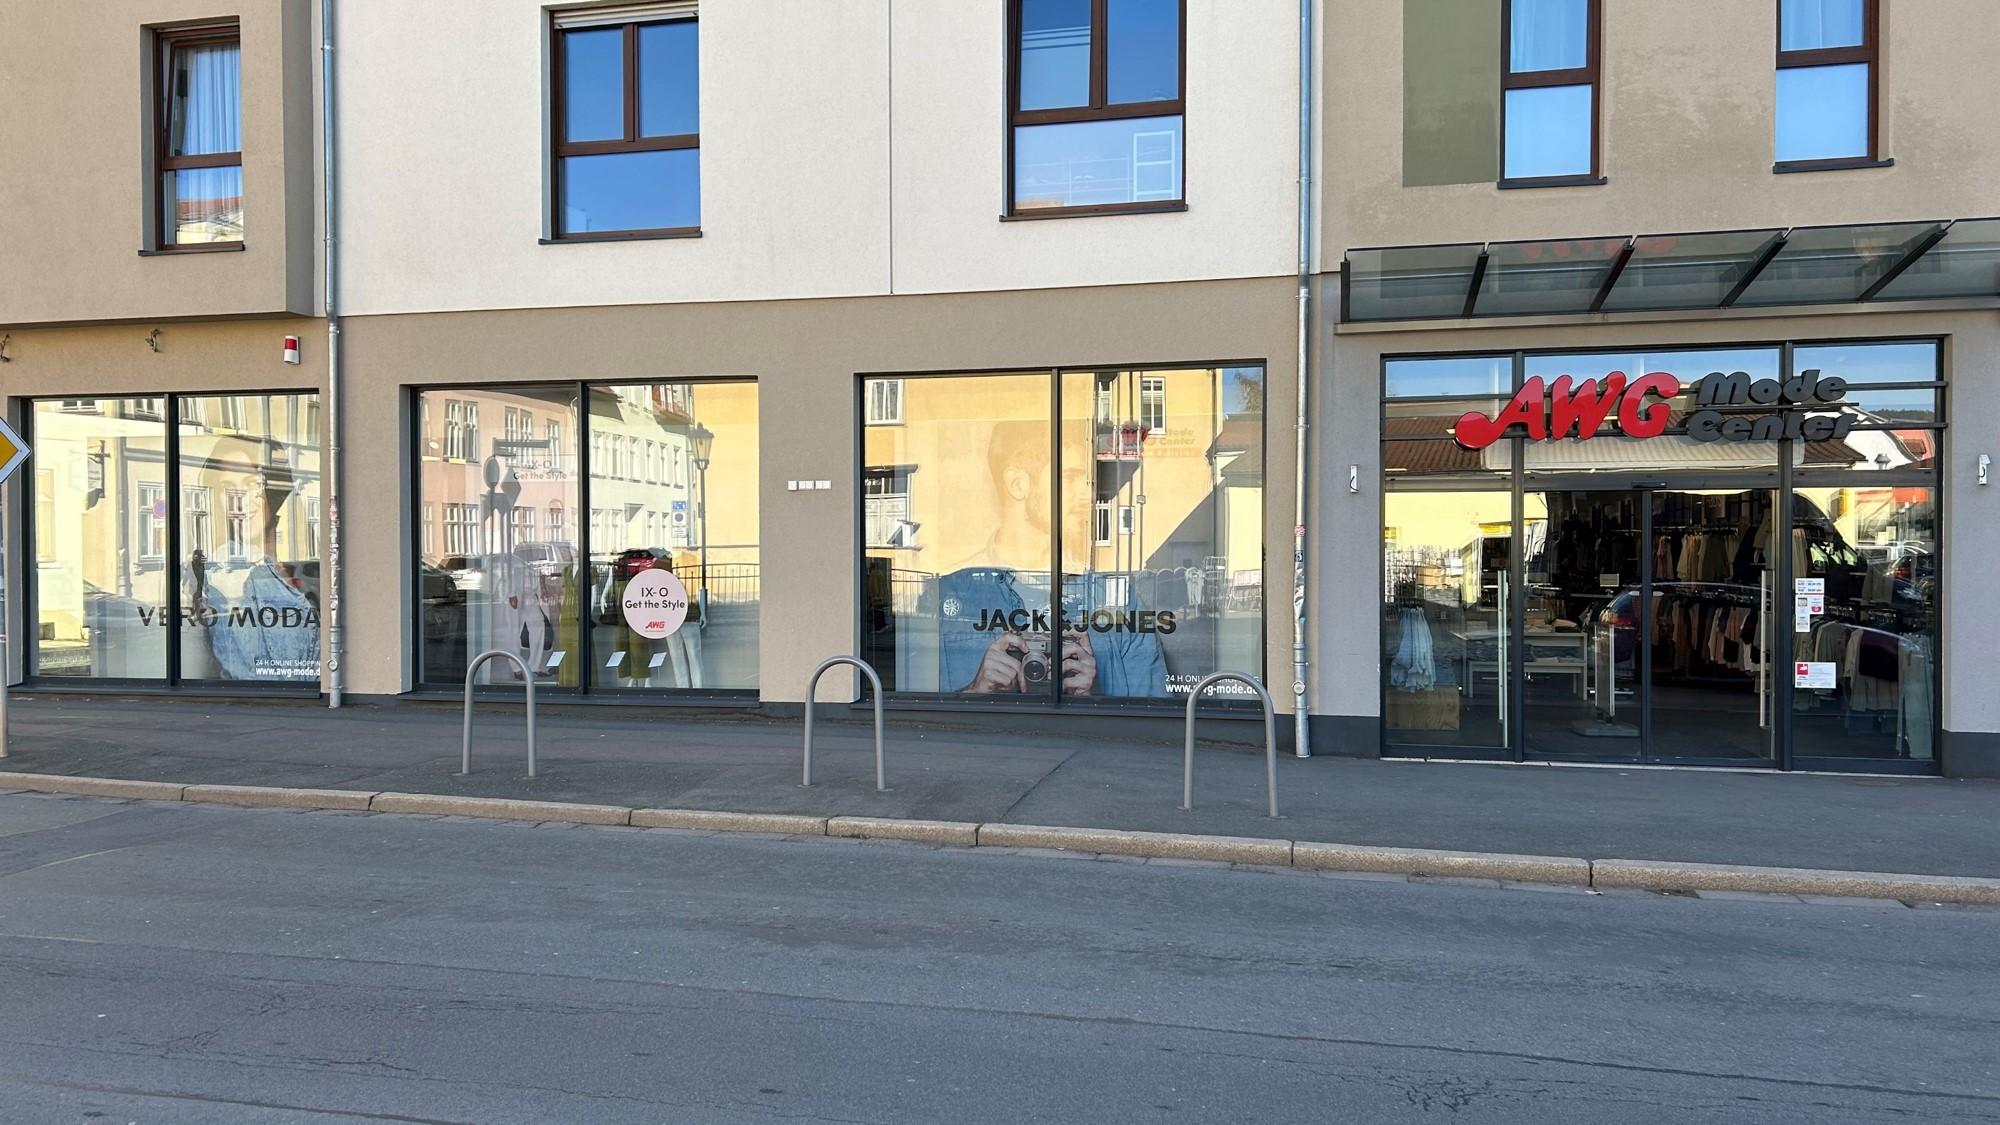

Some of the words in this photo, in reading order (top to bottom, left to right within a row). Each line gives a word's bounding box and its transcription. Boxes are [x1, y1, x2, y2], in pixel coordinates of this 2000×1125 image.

[1455, 371, 1680, 448] AWG
[1700, 370, 1847, 405] Mode
[1687, 411, 1859, 442] Center
[625, 600, 641, 608] Get
[644, 600, 660, 608] the
[662, 600, 685, 610] Style
[228, 607, 320, 628] MODA
[255, 667, 320, 678] www.awg-mode.d
[1165, 674, 1175, 682] 24
